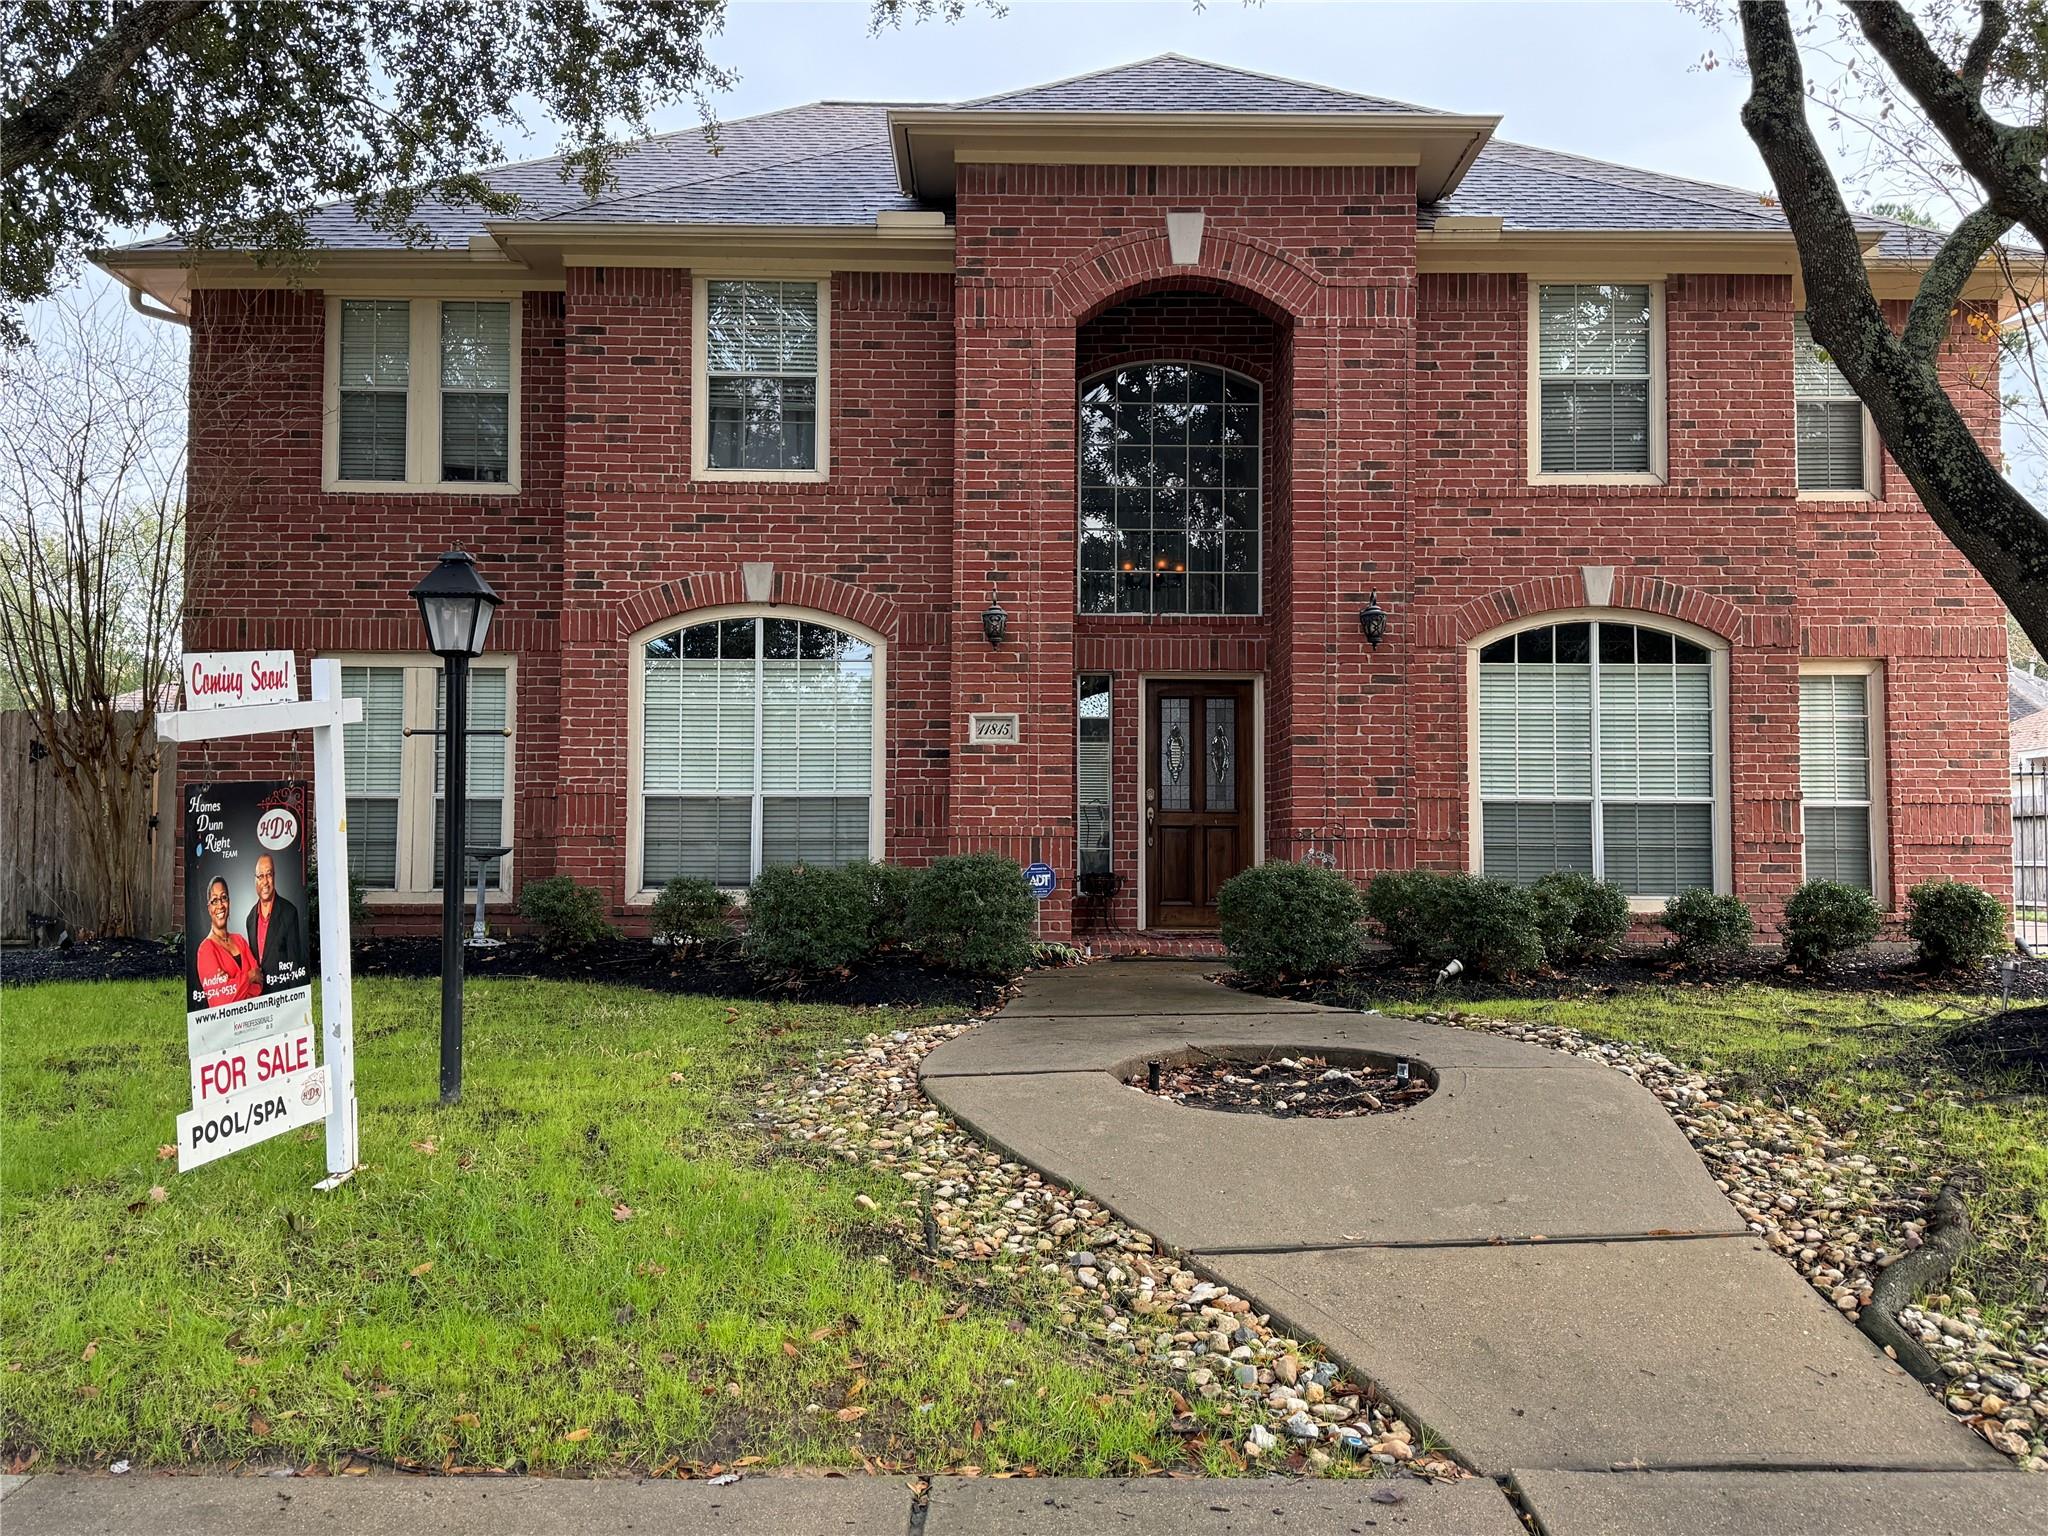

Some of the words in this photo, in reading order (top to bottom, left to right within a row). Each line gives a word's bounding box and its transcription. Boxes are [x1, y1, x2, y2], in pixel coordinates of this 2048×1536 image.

[191, 662, 243, 700] Coming
[251, 660, 289, 691] Soon!
[977, 723, 1010, 736] 11815
[188, 794, 221, 813] Homes
[196, 815, 224, 832] Dunn
[259, 816, 295, 839] HDR
[204, 833, 231, 853] Right
[222, 850, 238, 859] TEAM
[1030, 874, 1051, 887] ADT
[278, 961, 294, 972] Recy
[195, 990, 306, 1025] www.HomesDunnRight.com
[200, 1056, 247, 1100] FOR
[257, 1037, 309, 1082] SALE
[302, 1087, 321, 1101] HDR
[192, 1096, 287, 1149] POOL/SPA
